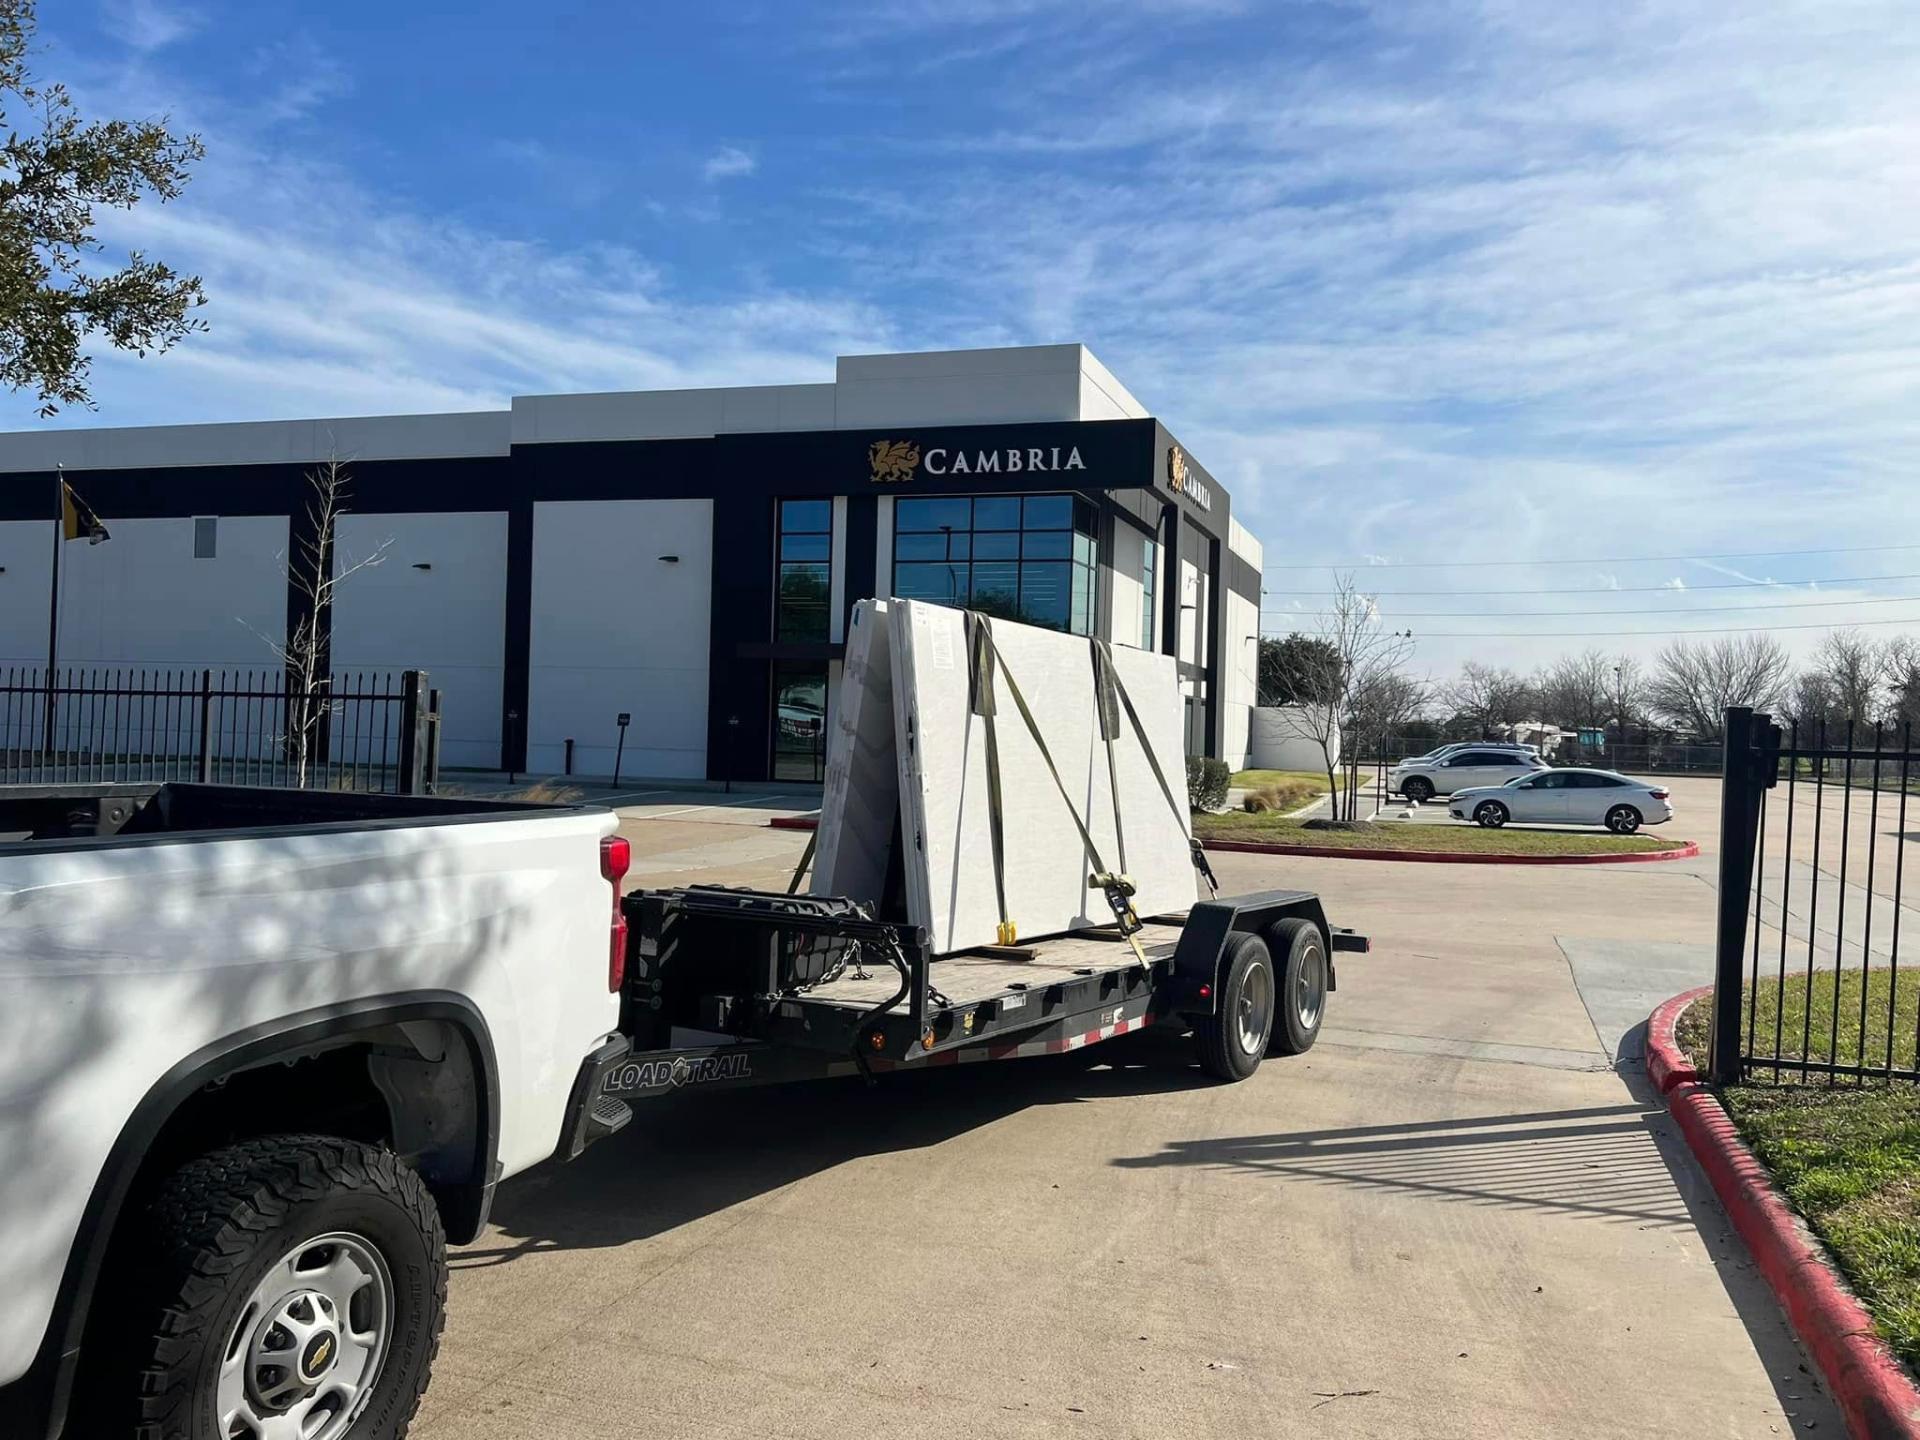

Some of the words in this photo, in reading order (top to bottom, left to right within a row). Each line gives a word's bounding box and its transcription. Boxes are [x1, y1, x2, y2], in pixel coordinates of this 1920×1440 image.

[924, 446, 1087, 474] CAMBRIA
[603, 1061, 674, 1091] LOAD
[684, 1054, 752, 1083] TRAIL
